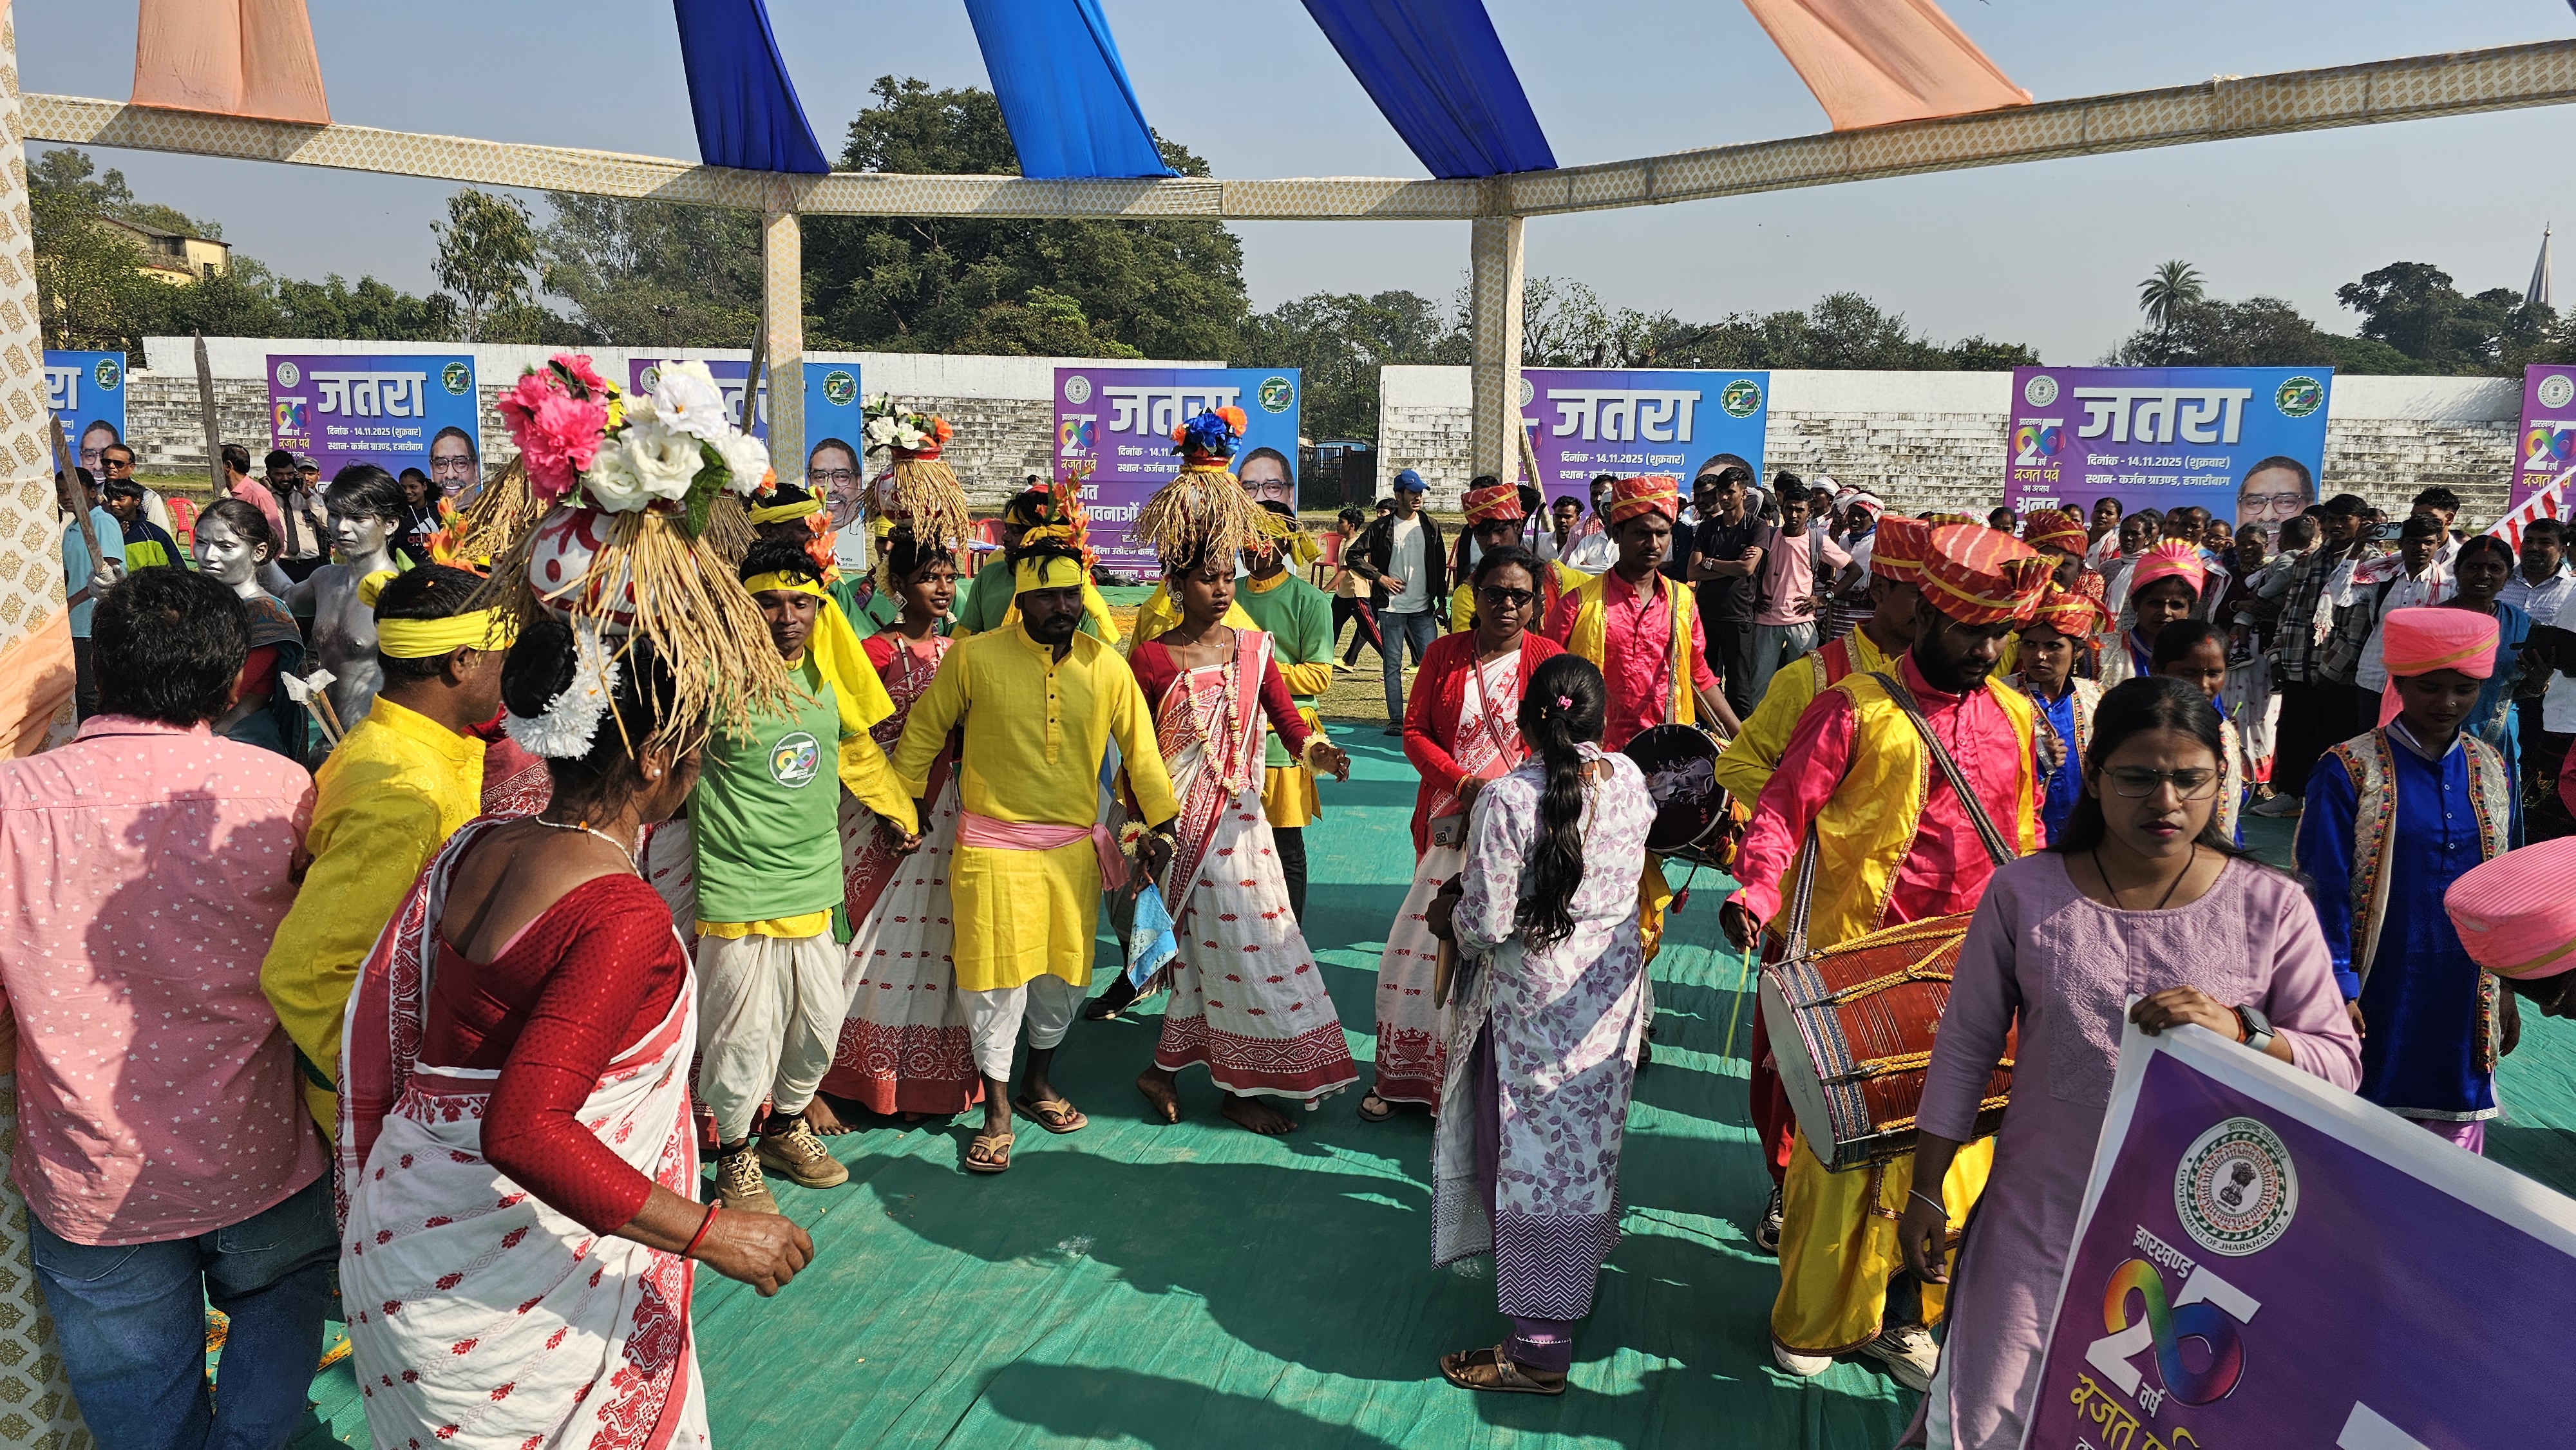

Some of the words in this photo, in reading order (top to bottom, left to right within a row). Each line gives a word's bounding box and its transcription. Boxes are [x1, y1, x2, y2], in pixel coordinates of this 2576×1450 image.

[44, 366, 81, 410] रा
[309, 372, 427, 417] जतरा
[1547, 389, 1701, 441] जतरा
[2073, 387, 2252, 444] जतरा
[2530, 420, 2555, 428] झारखण्ड
[327, 426, 349, 436] दिनांक
[354, 427, 390, 436] 14.11.2025
[392, 426, 421, 438] (शुक्रवार)
[327, 442, 350, 451] स्थान-
[350, 441, 369, 451] कर्जन
[392, 441, 423, 451] हजारीबाग
[1117, 446, 1142, 457] दिनांक
[1117, 464, 1142, 473] स्थान-
[1144, 462, 1166, 473] कर्जन
[1560, 451, 1589, 462] दिनांक
[1596, 453, 1643, 464] 14.11.2025
[1645, 453, 1685, 467] (शुक्रवार)
[2087, 454, 2119, 466] दिनांक
[2127, 457, 2182, 467] 14.11.2025
[2184, 456, 2230, 470] (शुक्रवार)
[2548, 460, 2559, 471] वर्ष
[2014, 469, 2041, 482] रजत
[2043, 462, 2063, 482] पर्व
[2085, 474, 2117, 485] स्थान-
[2119, 472, 2147, 485] कर्जन
[2148, 475, 2181, 487] ग्राउण्ड,
[2182, 474, 2231, 486] हजारीबाग
[2178, 1169, 2206, 1236] GOVERNMENT
[2206, 1237, 2218, 1247] OF
[2219, 1223, 2282, 1251] JHARKHAND
[2133, 1224, 2195, 1279] झारखण्ड
[2085, 1258, 2262, 1408] 25
[2139, 1382, 2166, 1418] वर्ष
